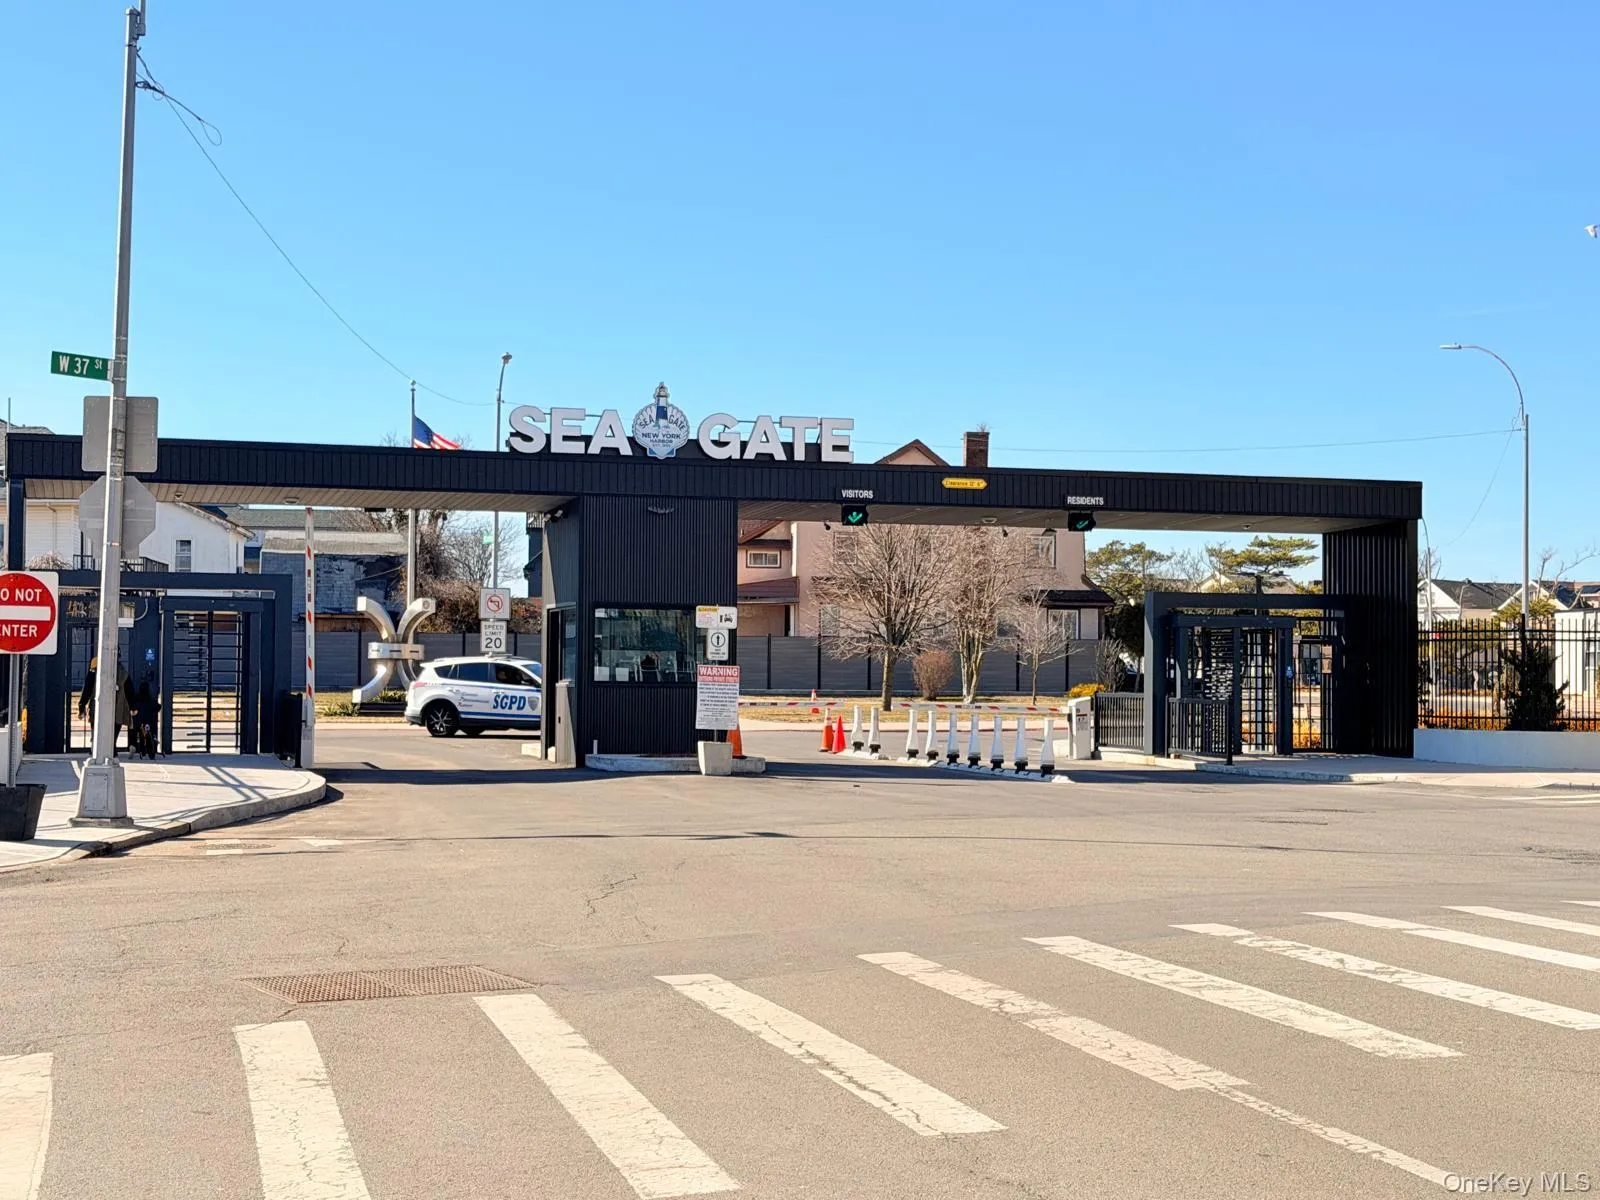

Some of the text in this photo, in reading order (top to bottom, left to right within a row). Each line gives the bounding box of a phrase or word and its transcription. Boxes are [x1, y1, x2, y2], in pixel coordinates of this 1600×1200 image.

[59, 355, 70, 373] W
[74, 357, 90, 375] 37
[639, 414, 686, 431] SEA GATE
[508, 405, 855, 463] SEA GATE
[841, 489, 874, 499] VISITORS
[1067, 496, 1104, 506] RESIDENTS
[15, 588, 42, 602] NOT
[0, 624, 38, 638] NTER
[485, 638, 502, 648] 20
[700, 666, 738, 676] WARNING
[493, 695, 526, 710] SGPD
